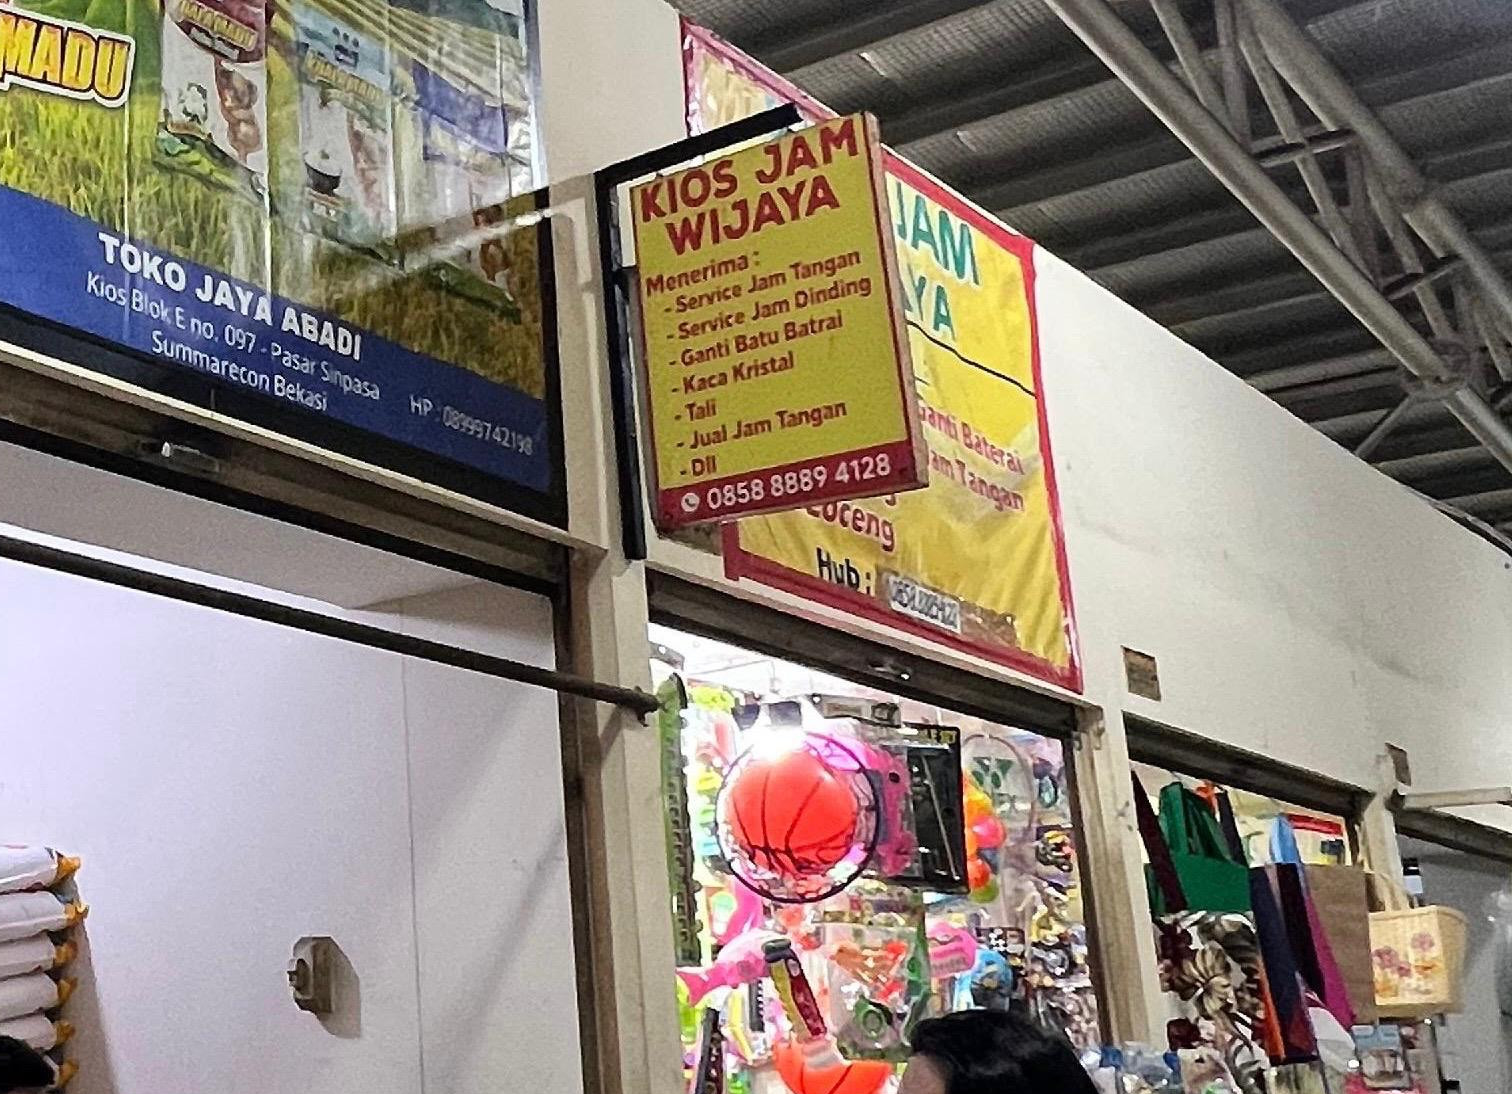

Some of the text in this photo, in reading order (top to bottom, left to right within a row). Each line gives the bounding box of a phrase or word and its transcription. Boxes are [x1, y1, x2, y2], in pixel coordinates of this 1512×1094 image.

[640, 118, 860, 223] KIOS JAM
[665, 174, 841, 257] WIJAYA
[896, 181, 980, 286] JAM
[98, 231, 362, 361] TOKO JAYA ABADI
[646, 253, 749, 298] Menerima
[675, 251, 862, 313] Service Jam Tangan
[87, 270, 127, 307] Kios
[131, 287, 175, 323] Blok
[175, 306, 187, 330] E
[224, 323, 257, 355] 097
[270, 342, 317, 375] Pasar
[320, 360, 381, 401] Sinpasa
[678, 276, 872, 340] Service Jam Dinding
[151, 329, 328, 412] Summarecon Bekasi
[680, 340, 731, 368] Ganti
[734, 330, 780, 354] Batu
[682, 350, 794, 396] Kaca Kristal
[409, 394, 435, 417] HP
[685, 399, 718, 422] Tali
[690, 401, 848, 450] Jual Jam Tangan
[961, 420, 1026, 476] Baterai
[706, 452, 892, 511] 0858 8889 4128
[815, 546, 862, 592] Hub
